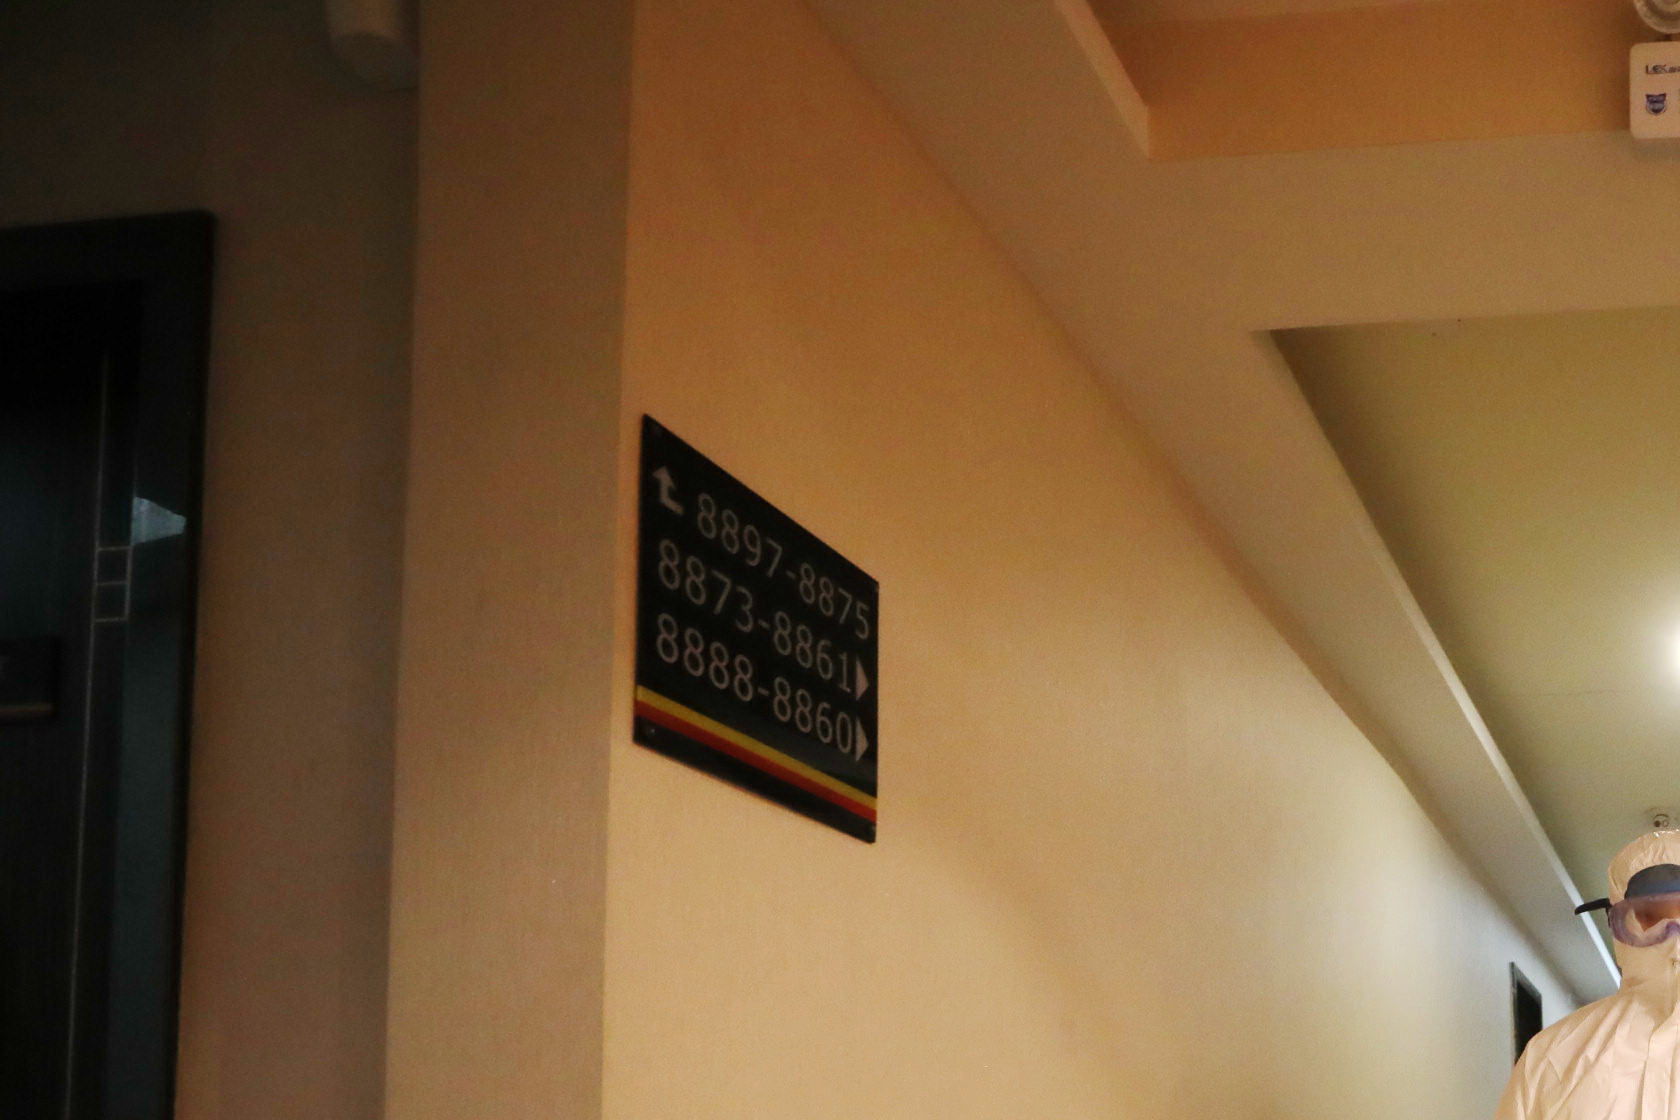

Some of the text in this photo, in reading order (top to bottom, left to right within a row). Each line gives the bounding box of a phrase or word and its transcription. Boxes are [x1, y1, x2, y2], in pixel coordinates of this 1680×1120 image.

[658, 539, 851, 693] 8873-8861
[697, 492, 870, 640] 8897-8875
[656, 613, 852, 754] 8888-8860
